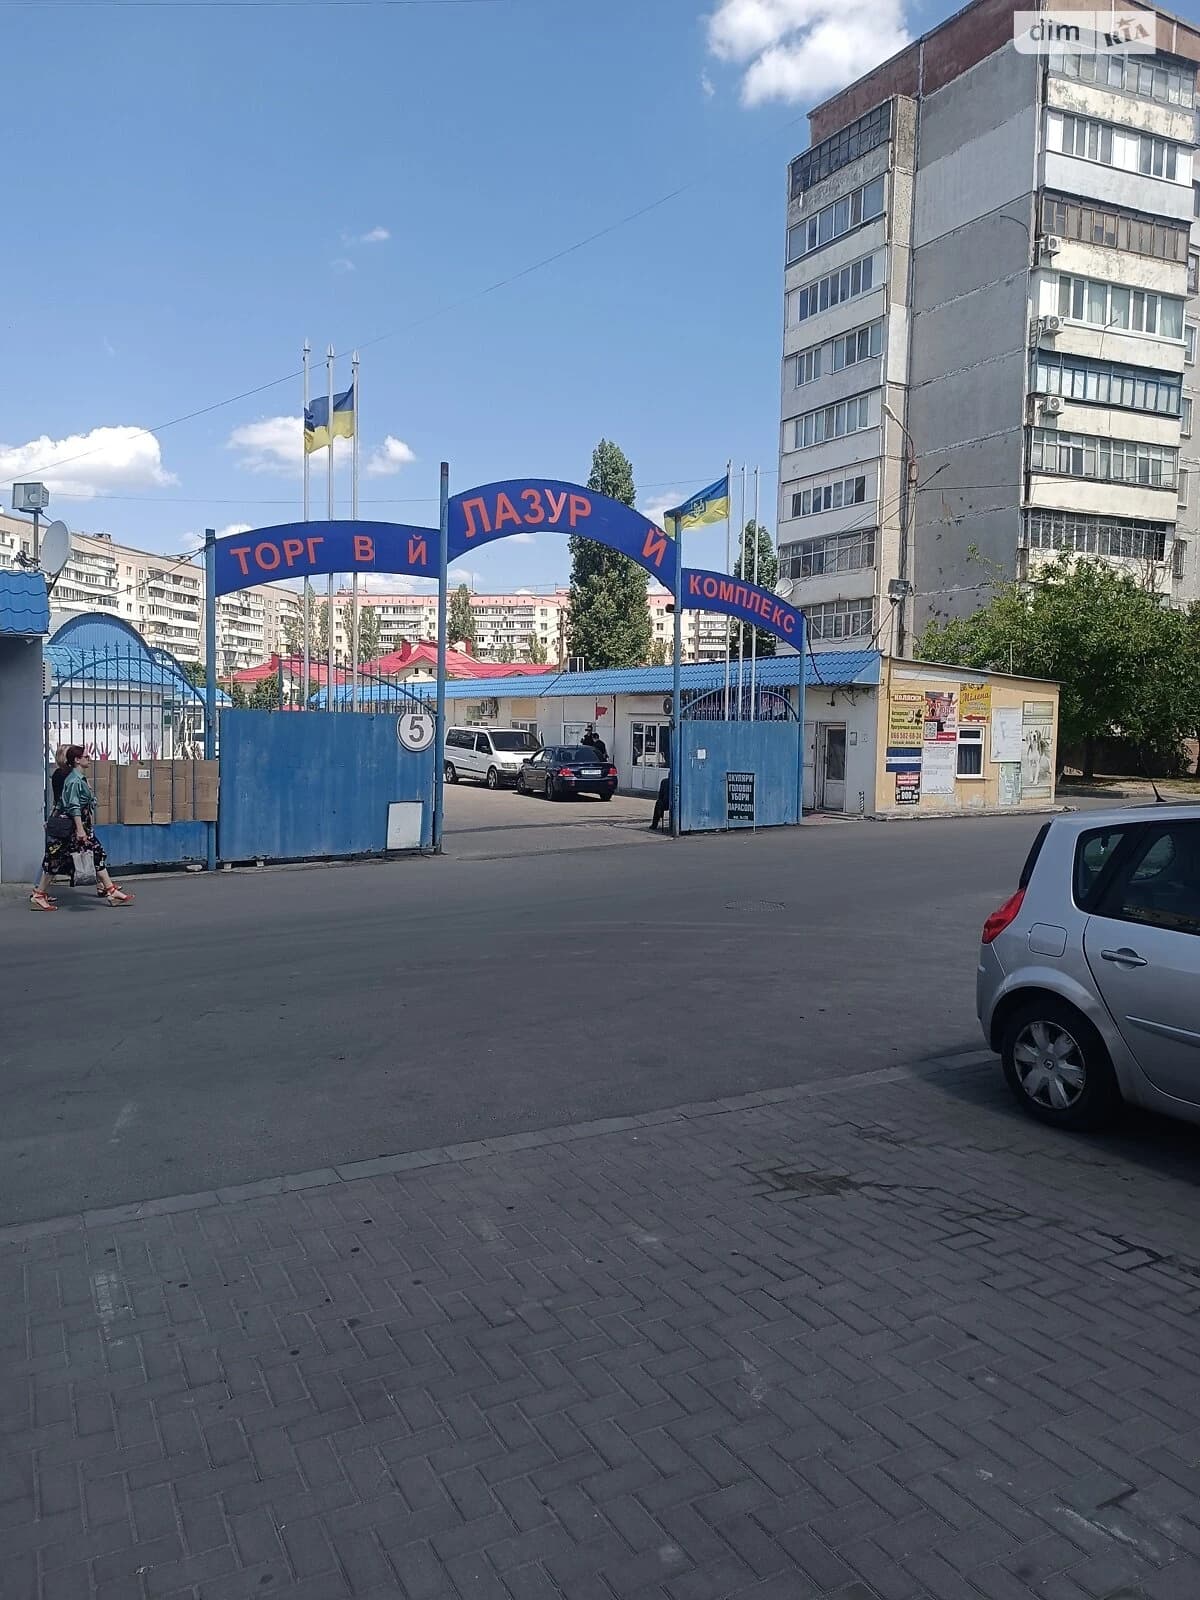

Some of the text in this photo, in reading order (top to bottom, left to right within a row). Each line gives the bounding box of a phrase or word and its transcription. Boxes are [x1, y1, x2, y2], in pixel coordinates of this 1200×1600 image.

[461, 488, 593, 538] ЛАЗУР
[229, 536, 324, 575] ТОРГ
[688, 573, 796, 635] КОМПЛЕКС
[409, 716, 425, 743] 5
[731, 793, 750, 801] УБОРИ
